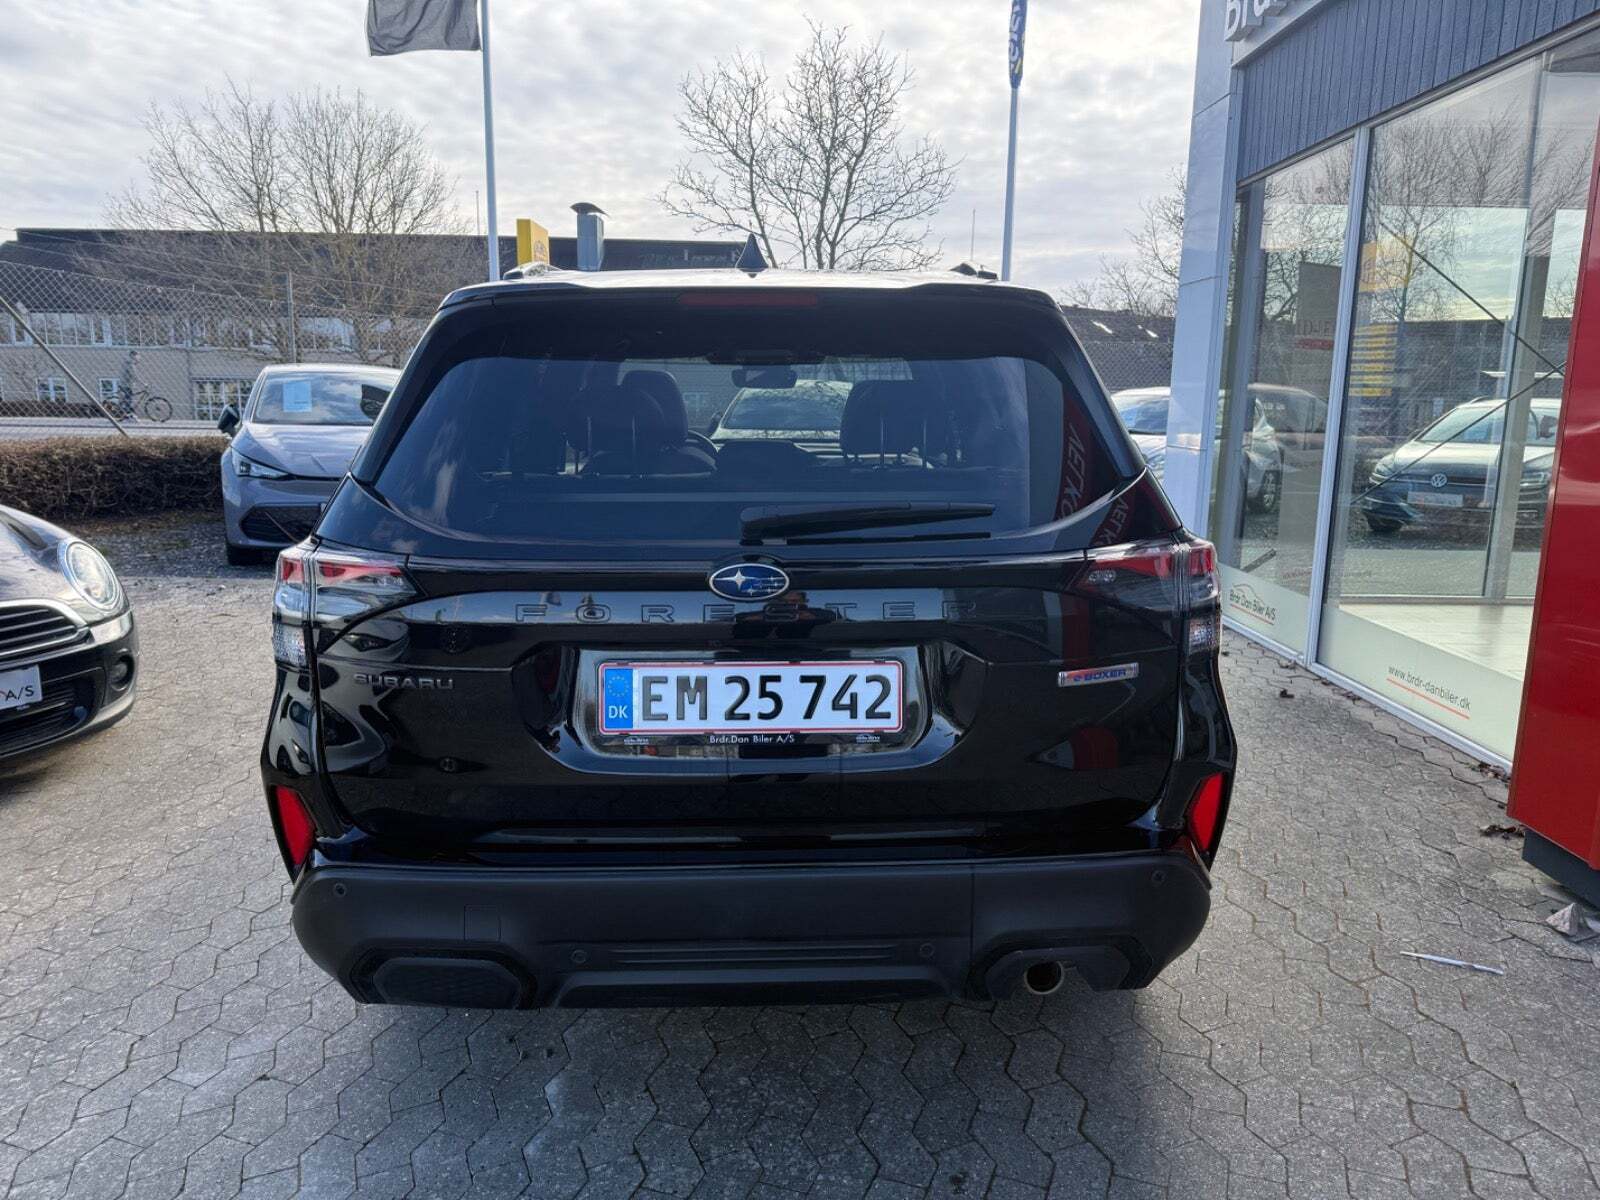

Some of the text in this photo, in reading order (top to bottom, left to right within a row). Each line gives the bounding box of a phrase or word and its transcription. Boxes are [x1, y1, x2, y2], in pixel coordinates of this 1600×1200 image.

[515, 601, 977, 624] FORESTER
[353, 672, 453, 690] SUBARU
[5, 685, 34, 702] A/S
[642, 674, 892, 721] EM 25 742
[608, 705, 628, 719] DK
[753, 734, 772, 744] Biler
[776, 734, 795, 744] A/S
